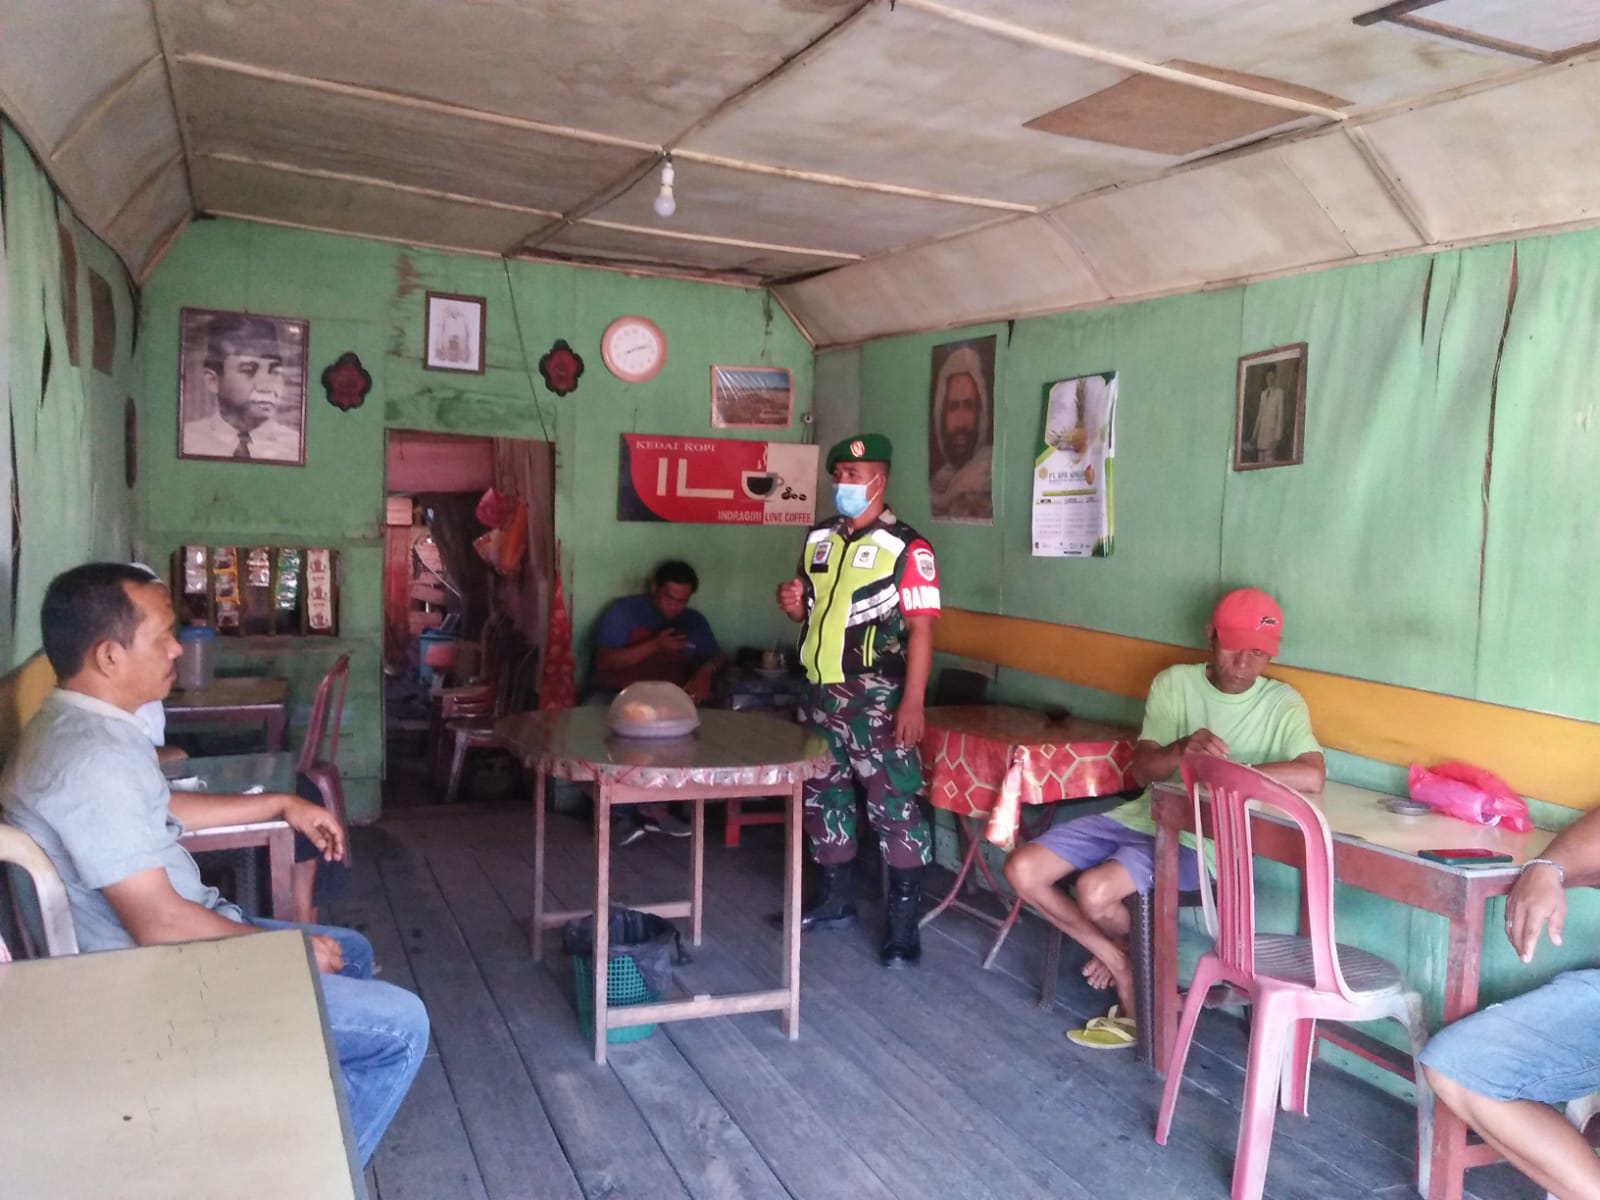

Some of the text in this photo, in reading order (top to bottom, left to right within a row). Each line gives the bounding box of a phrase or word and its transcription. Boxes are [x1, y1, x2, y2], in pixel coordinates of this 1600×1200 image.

[636, 439, 715, 453] KEDAI KOPI
[656, 457, 734, 499] IL
[718, 510, 811, 523] INDRAGIRI LOVE COFFEE
